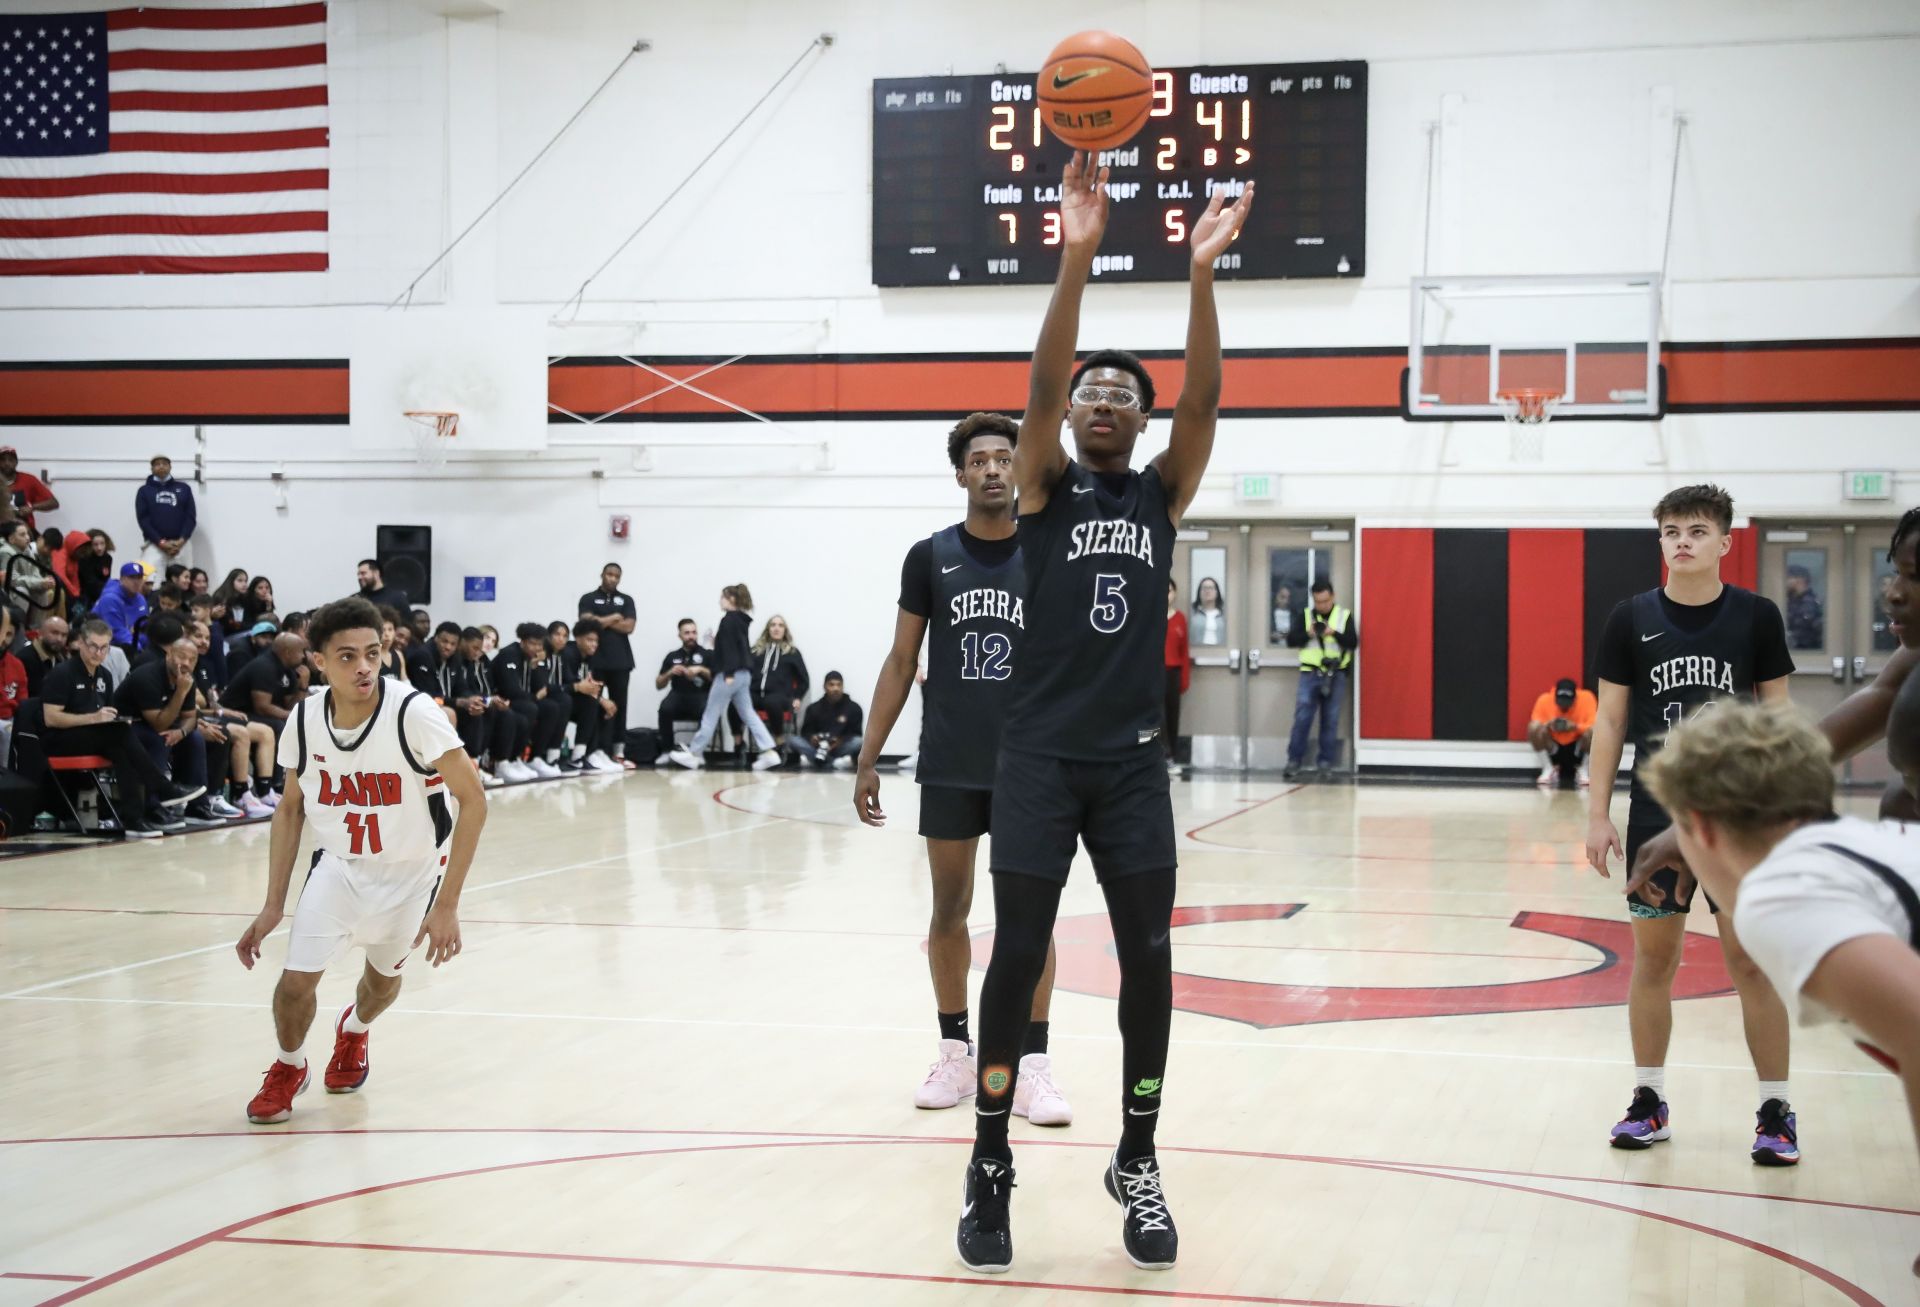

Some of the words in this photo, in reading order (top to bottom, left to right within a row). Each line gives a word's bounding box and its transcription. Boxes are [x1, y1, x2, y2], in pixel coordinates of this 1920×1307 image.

[990, 81, 1032, 102] Cavs
[1190, 73, 1249, 95] Guests
[989, 106, 1041, 150] 21
[1053, 109, 1113, 128] ELITE
[1197, 99, 1251, 141] 41
[1088, 146, 1139, 168] eriod
[1157, 137, 1177, 171] 2
[984, 184, 1022, 204] fouls
[999, 213, 1017, 244] 7
[1043, 212, 1061, 245] 3
[1165, 209, 1185, 242] 5
[987, 259, 1019, 275] won
[1092, 255, 1134, 276] game
[1243, 475, 1270, 497] EXIT
[1853, 474, 1883, 497] EXIT
[1067, 519, 1154, 568] SIERRA
[951, 588, 1025, 630] SIERRA
[1090, 573, 1129, 633] 5
[961, 632, 1012, 680] 12
[1650, 655, 1735, 697] SIERRA
[318, 769, 402, 806] LAND
[343, 811, 383, 855] 11
[1139, 1077, 1161, 1089] NIKE
